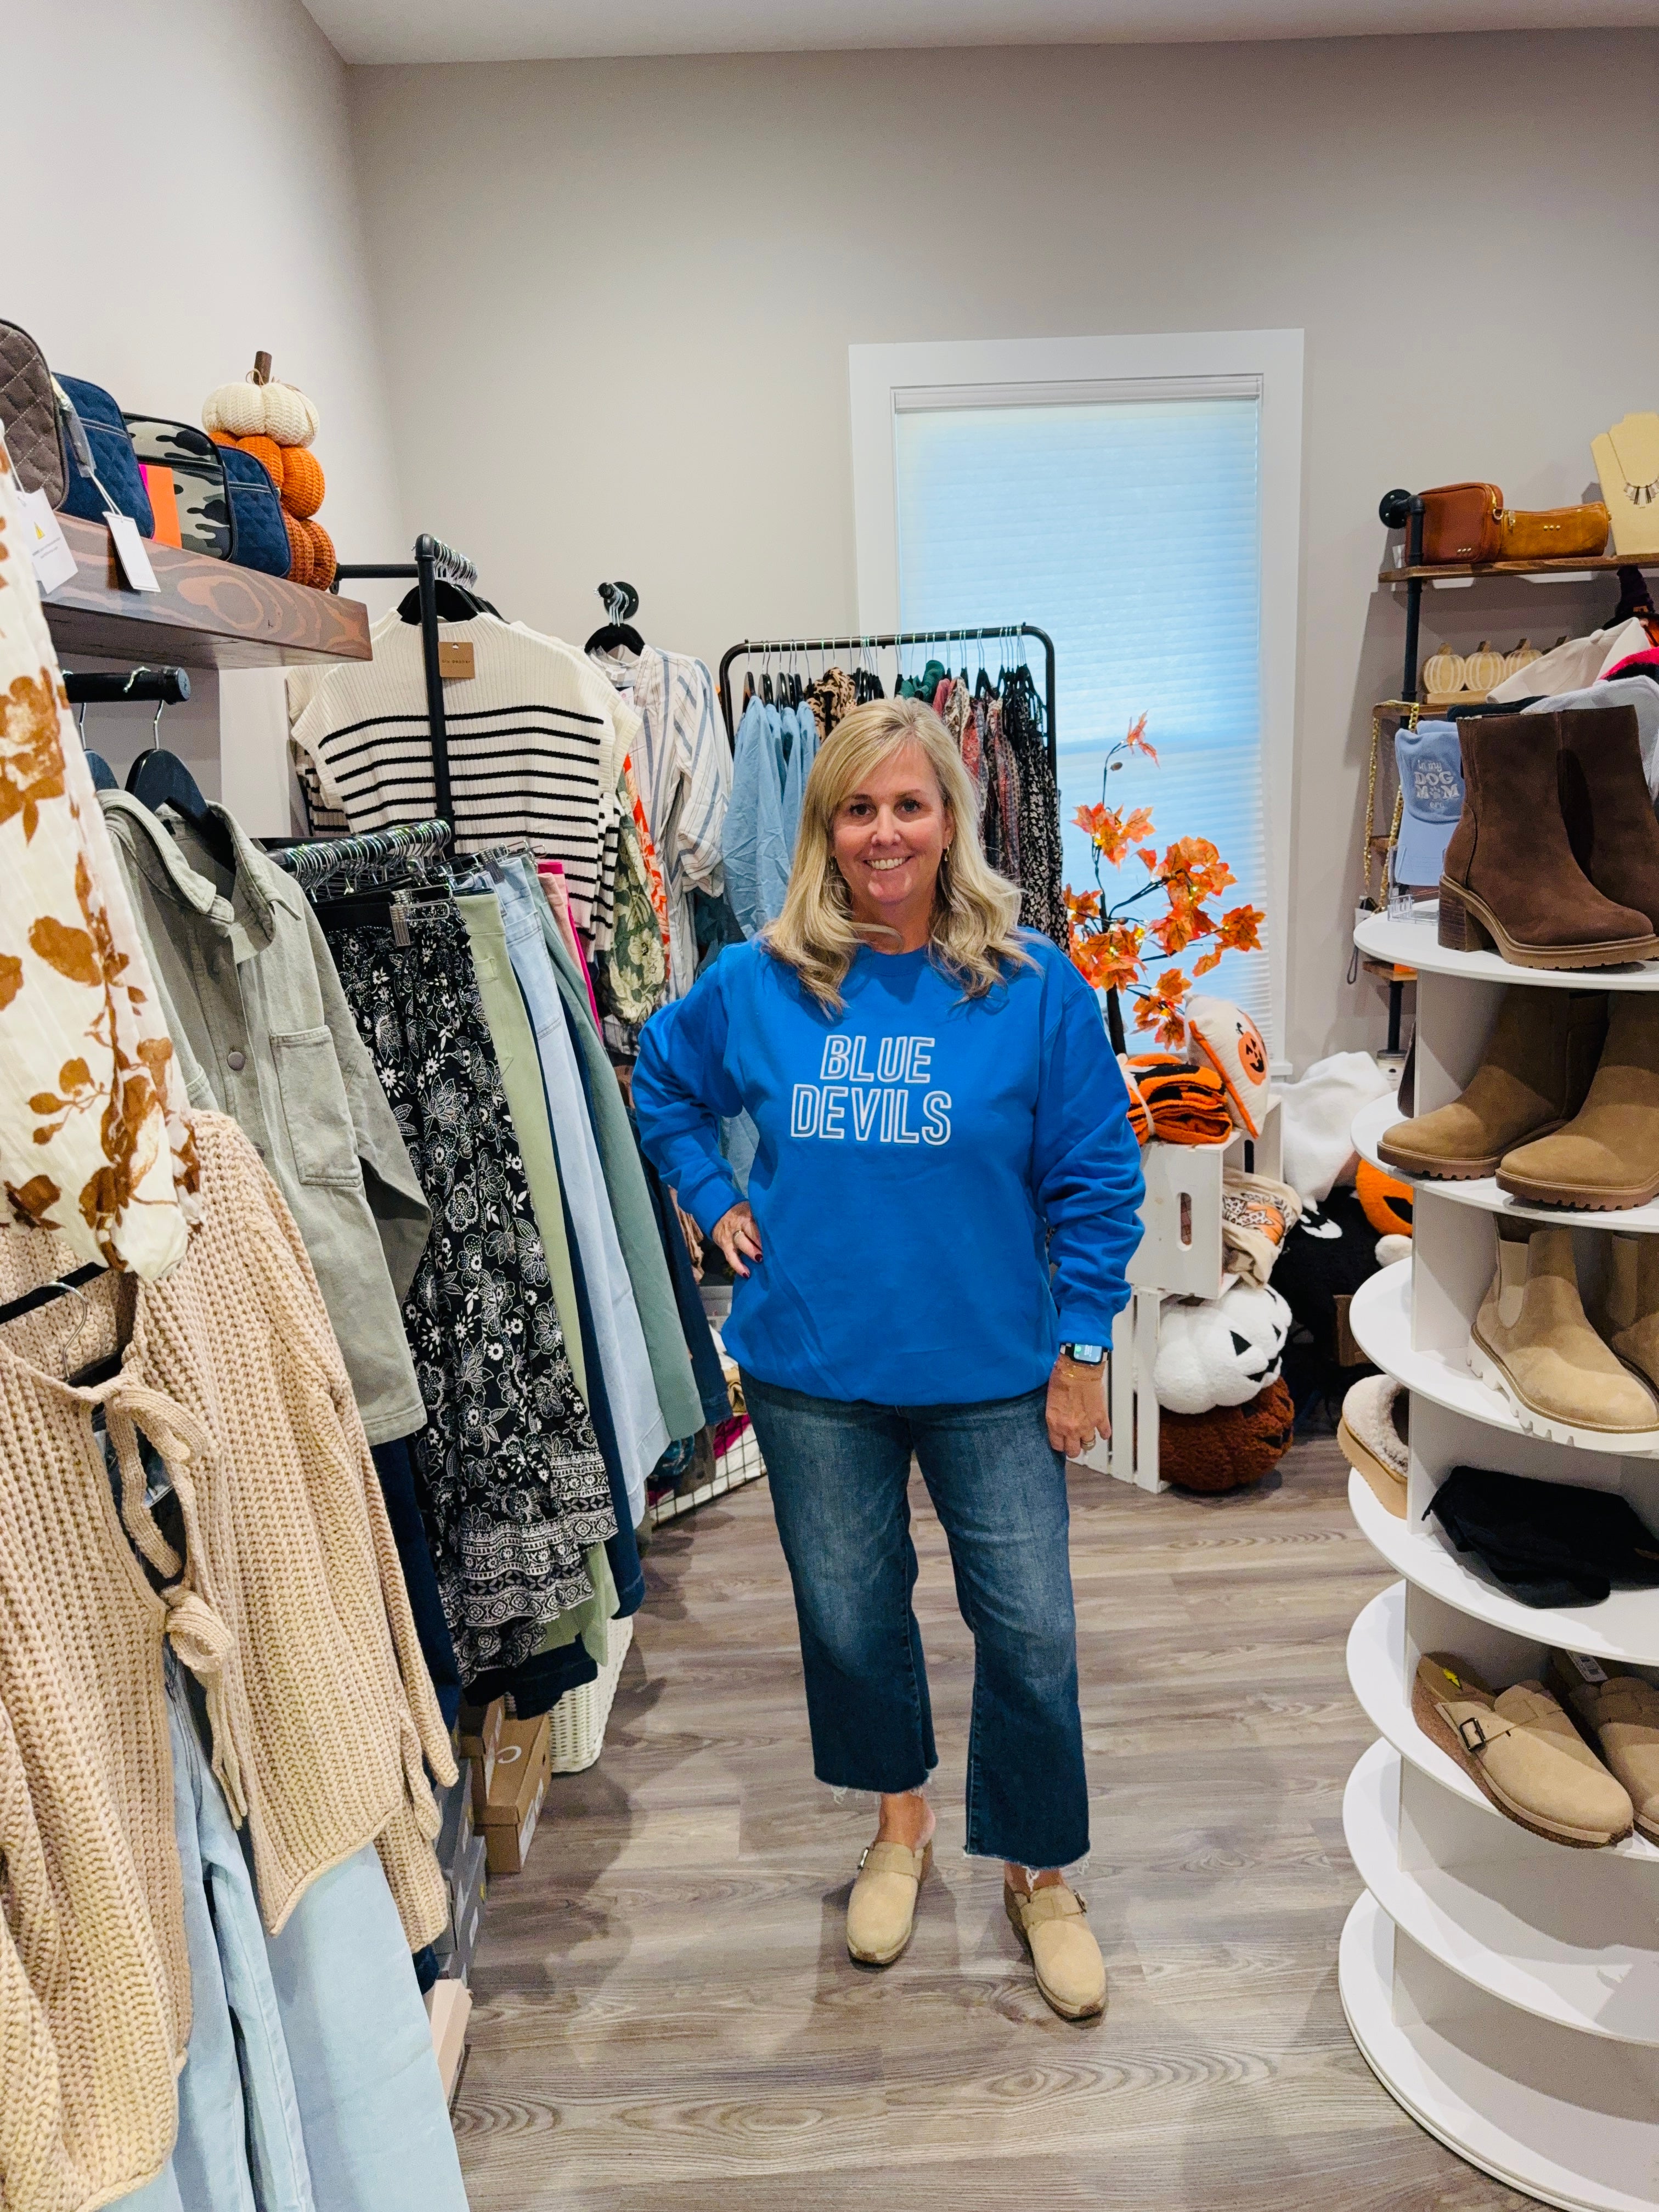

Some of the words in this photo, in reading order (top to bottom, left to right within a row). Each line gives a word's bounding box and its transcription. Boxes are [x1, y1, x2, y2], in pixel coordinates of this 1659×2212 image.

[1417, 760, 1426, 770] in
[1427, 762, 1442, 772] my
[1414, 771, 1454, 786] DOG
[1415, 784, 1459, 799] MM
[820, 1035, 935, 1084] BLUE
[791, 1084, 952, 1146] DEVILS
